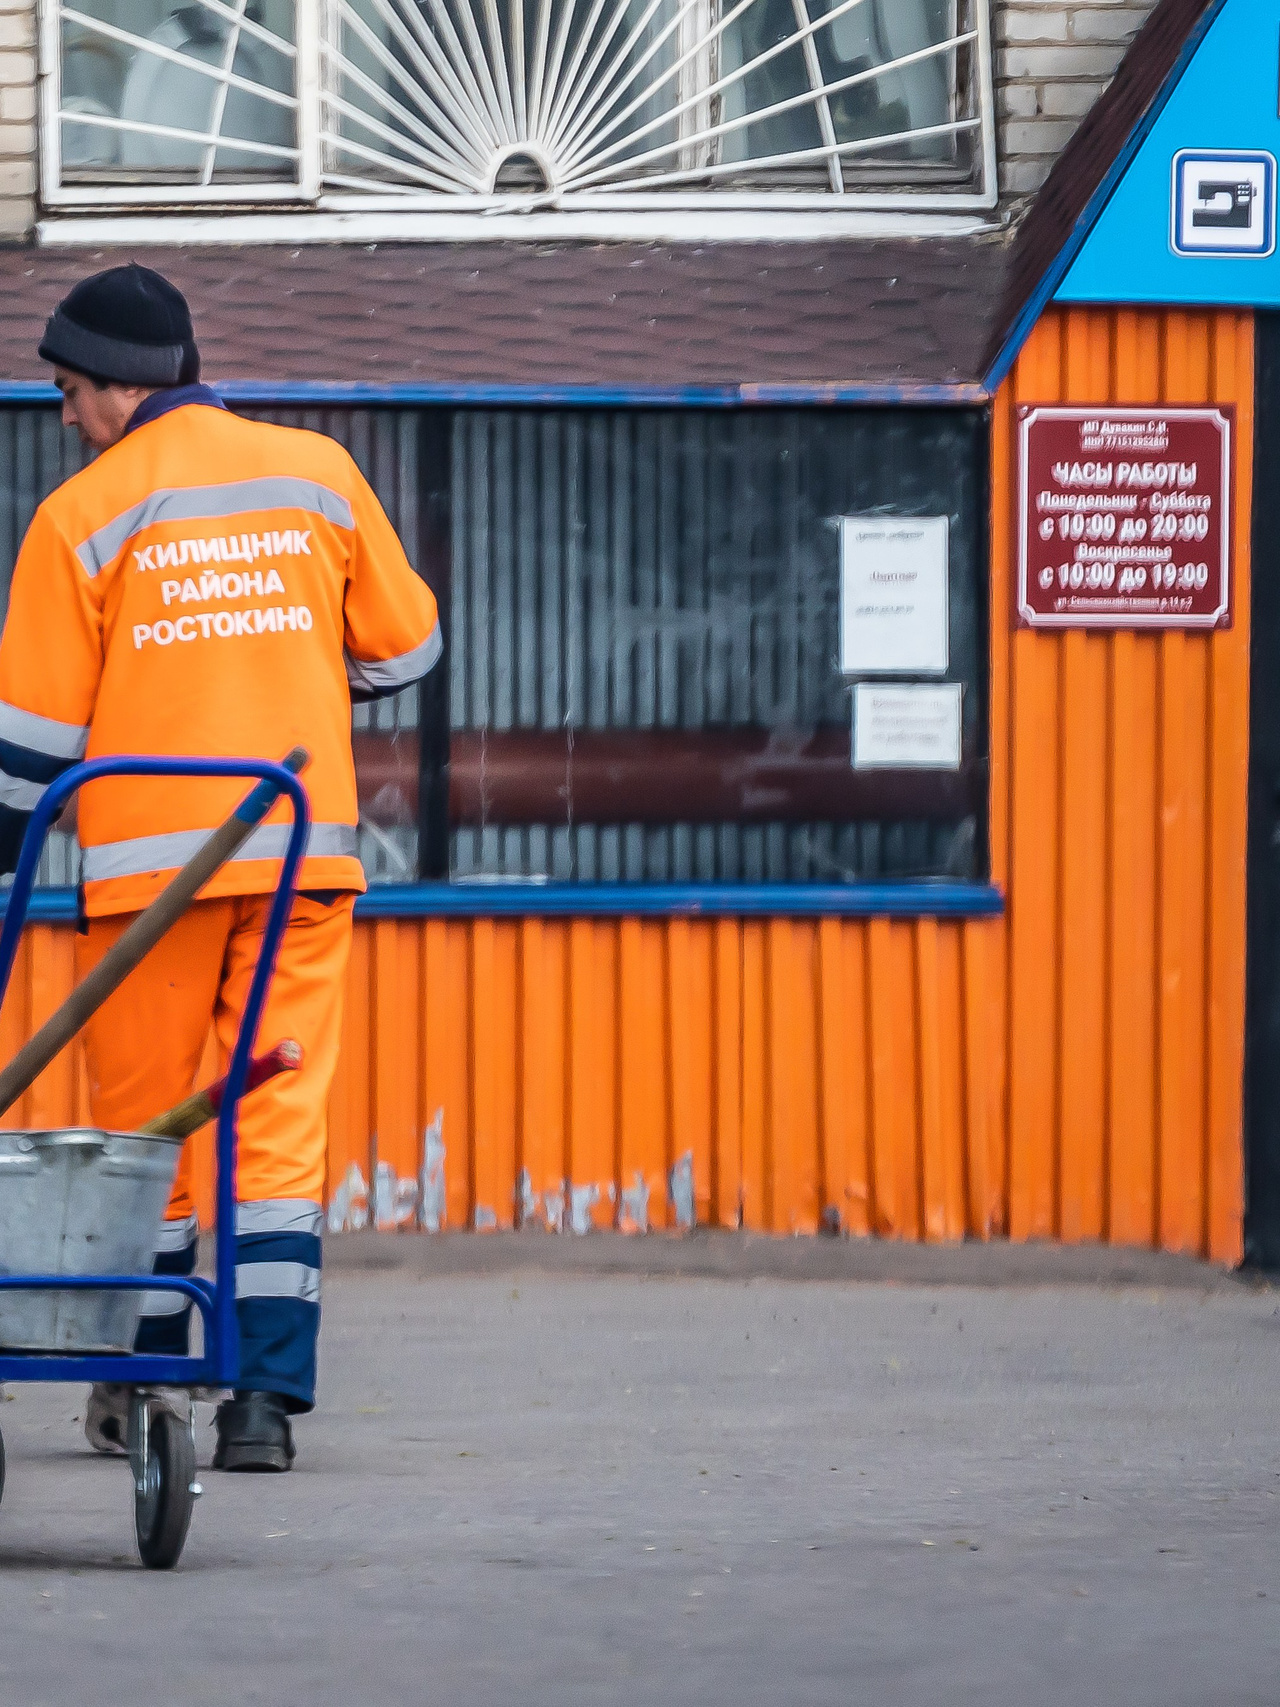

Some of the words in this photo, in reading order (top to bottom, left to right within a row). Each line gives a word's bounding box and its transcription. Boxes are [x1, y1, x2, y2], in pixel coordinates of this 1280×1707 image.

[1053, 462, 1113, 487] ЧАСЫ
[1117, 462, 1197, 487] РАБОТЫ
[1038, 491, 1137, 512] Понедельник
[1150, 491, 1211, 512] Суббота
[1039, 517, 1054, 540] с
[1059, 513, 1116, 540] 10:00
[1118, 518, 1147, 542] до
[1151, 513, 1209, 541] 20:00
[1075, 543, 1172, 563] Воскресенье
[161, 569, 285, 605] РАЙОНА
[1039, 566, 1054, 589] с
[1059, 562, 1116, 590] 10:00
[1118, 567, 1147, 591] до
[1153, 562, 1208, 590] 19:00
[133, 605, 313, 649] РОСТОКИНО
